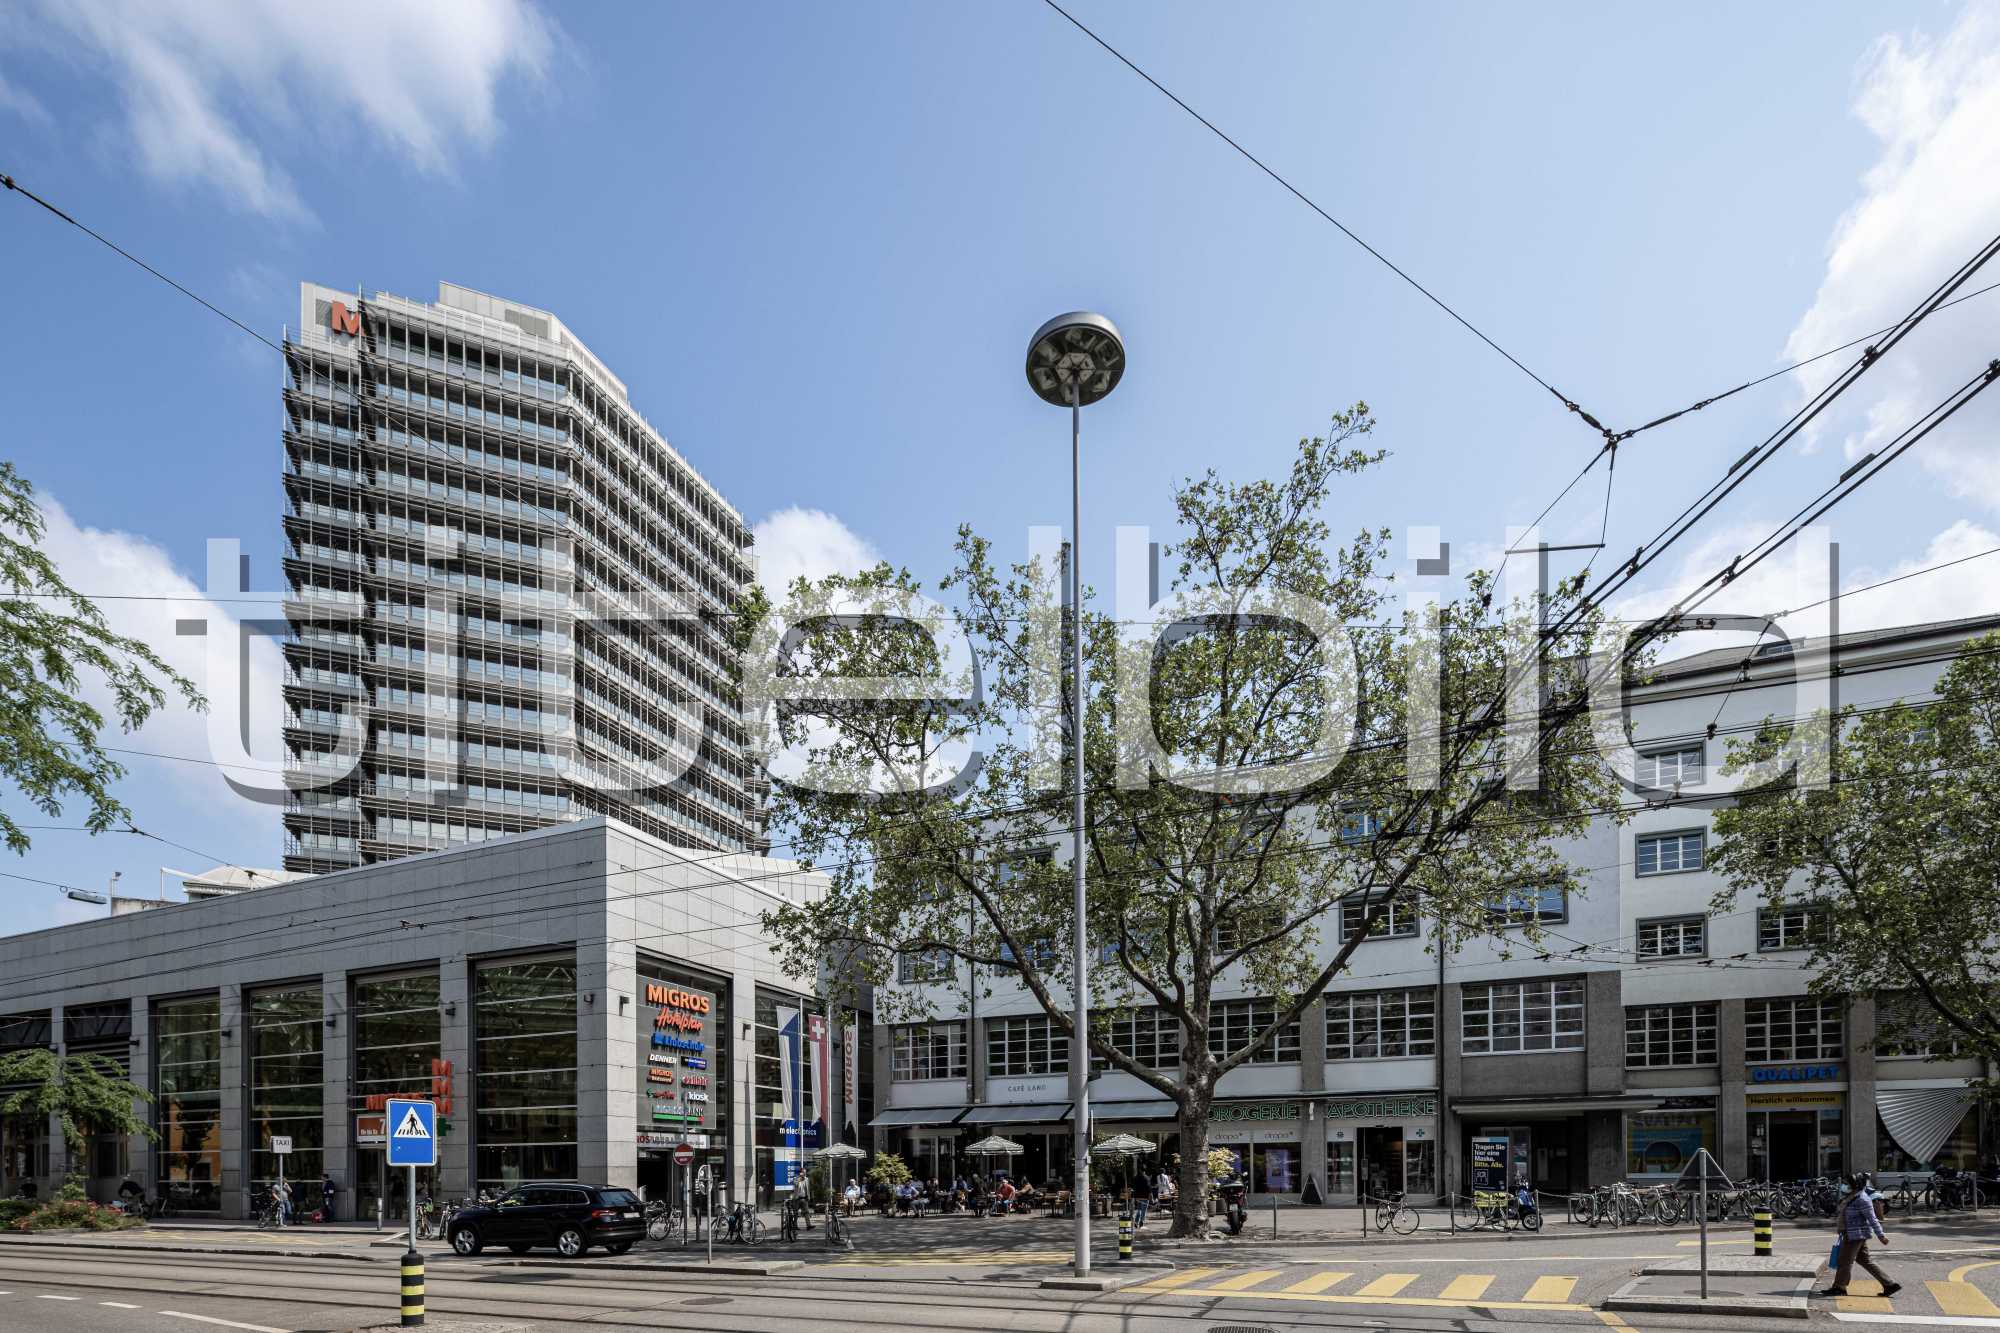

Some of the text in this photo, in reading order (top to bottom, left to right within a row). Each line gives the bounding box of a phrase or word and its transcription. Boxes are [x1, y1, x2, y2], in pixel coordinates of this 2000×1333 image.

[331, 299, 364, 337] M
[646, 982, 710, 1014] MIGROS
[656, 1007, 704, 1033] Hotelplan
[649, 1053, 677, 1065] DENNER
[1327, 1098, 1434, 1119] APOTHEKE
[274, 1137, 292, 1146] TAXI
